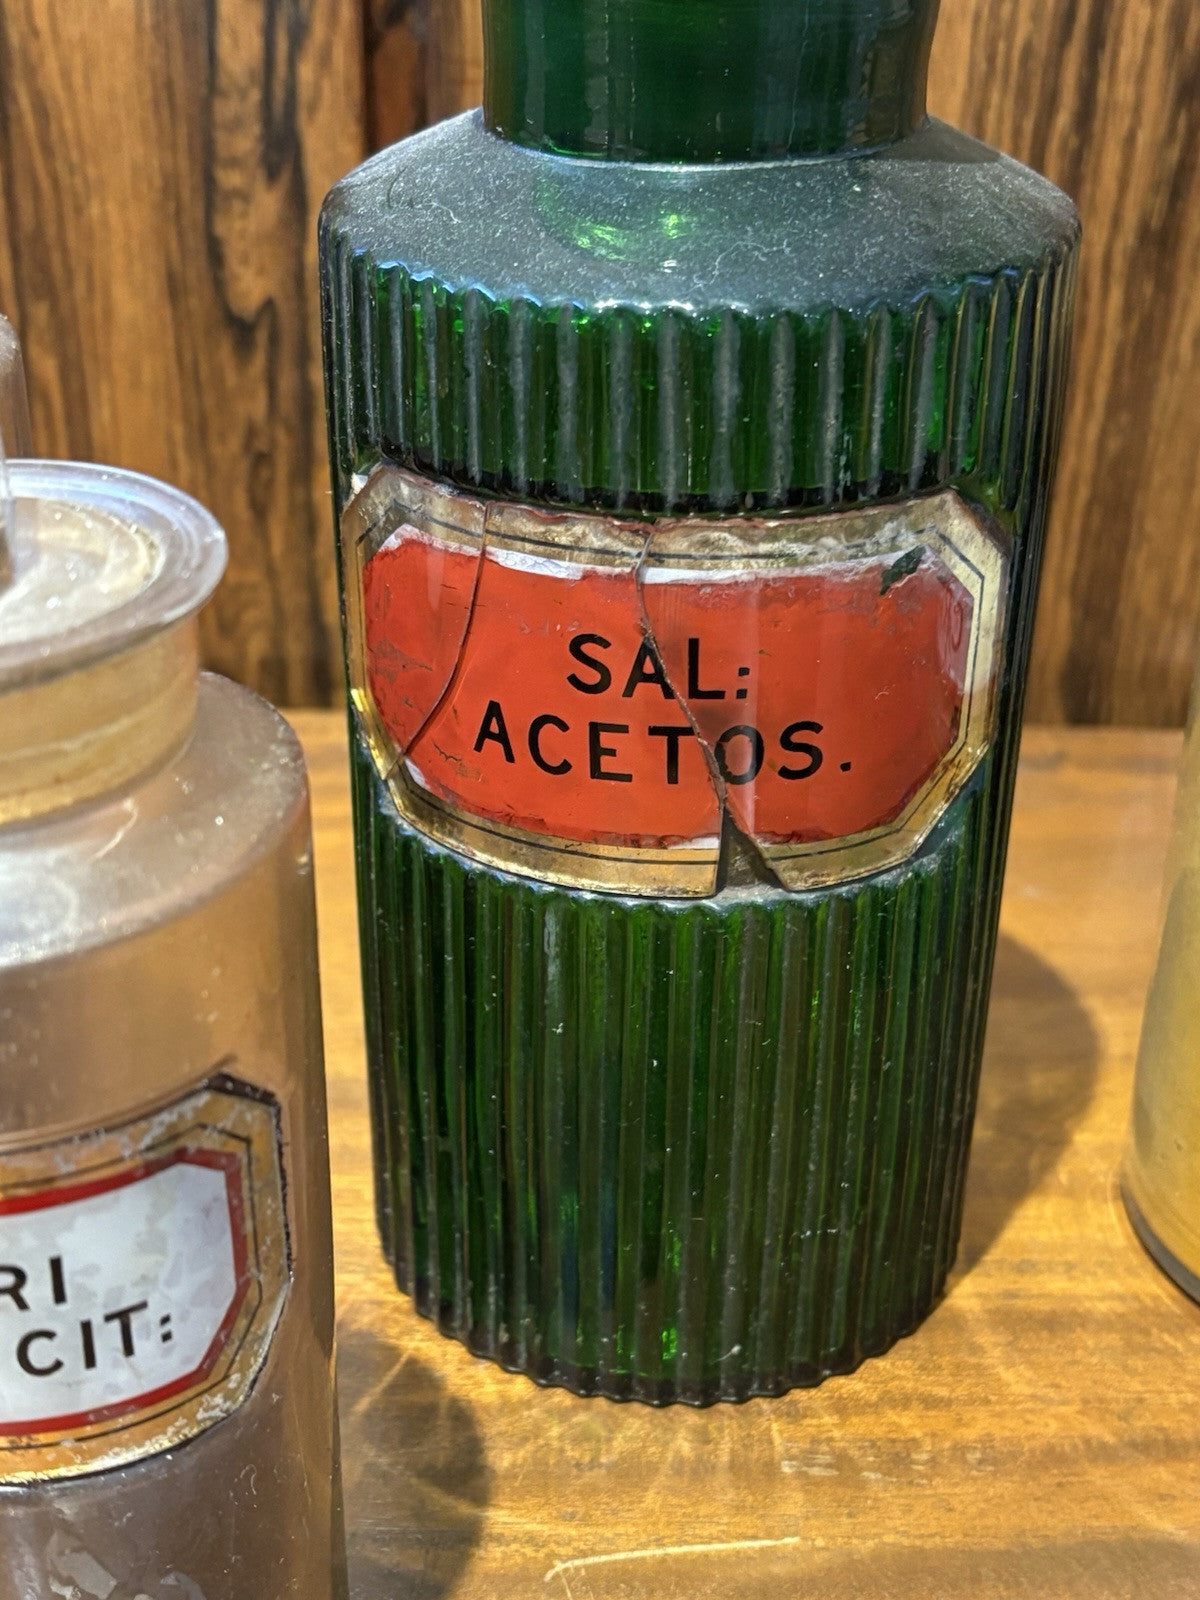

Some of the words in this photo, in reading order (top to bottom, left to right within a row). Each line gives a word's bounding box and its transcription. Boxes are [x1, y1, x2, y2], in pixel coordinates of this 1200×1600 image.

[566, 632, 751, 700] SAL:
[472, 699, 852, 785] ACETOS.
[16, 1300, 173, 1376] CIT:
